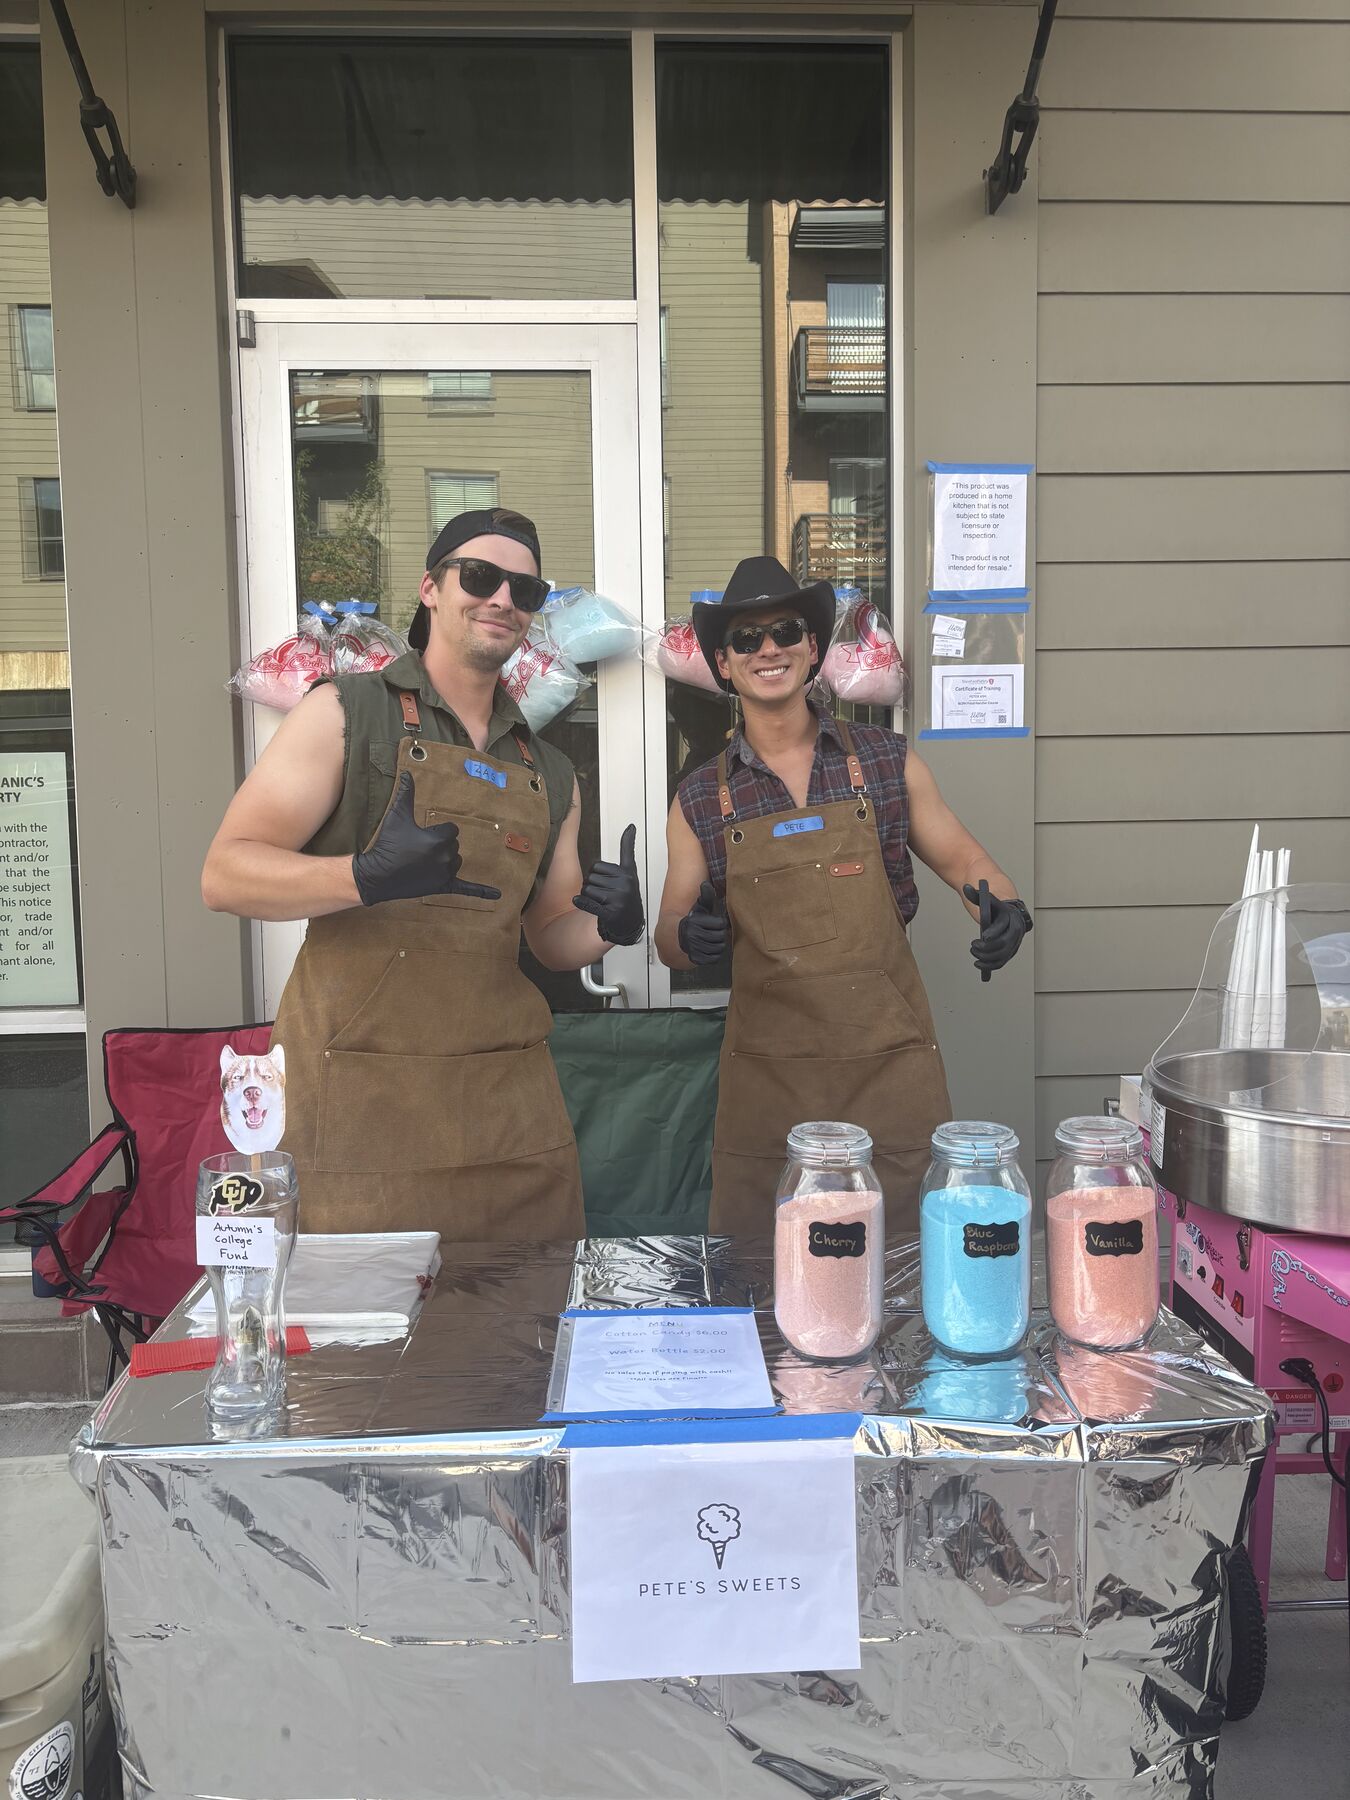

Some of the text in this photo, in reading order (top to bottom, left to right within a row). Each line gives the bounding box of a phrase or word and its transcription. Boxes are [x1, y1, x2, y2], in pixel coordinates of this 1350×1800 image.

[4, 822, 28, 832] with
[30, 822, 48, 832] the
[14, 852, 49, 862] and/or
[6, 867, 50, 878] that the
[12, 882, 51, 894] subject
[19, 896, 52, 906] notice
[25, 912, 52, 922] trade
[18, 926, 53, 936] and/or
[16, 940, 30, 950] for
[42, 940, 54, 950] all
[24, 956, 56, 966] alone,
[222, 1179, 248, 1205] CU
[213, 1222, 263, 1234] Autumn's
[966, 1226, 995, 1238] Blue
[814, 1232, 856, 1252] Cherry
[1090, 1234, 1134, 1248] Vanilla
[220, 1248, 248, 1260] Fund
[639, 1577, 800, 1597] PETE'S SWEETS
